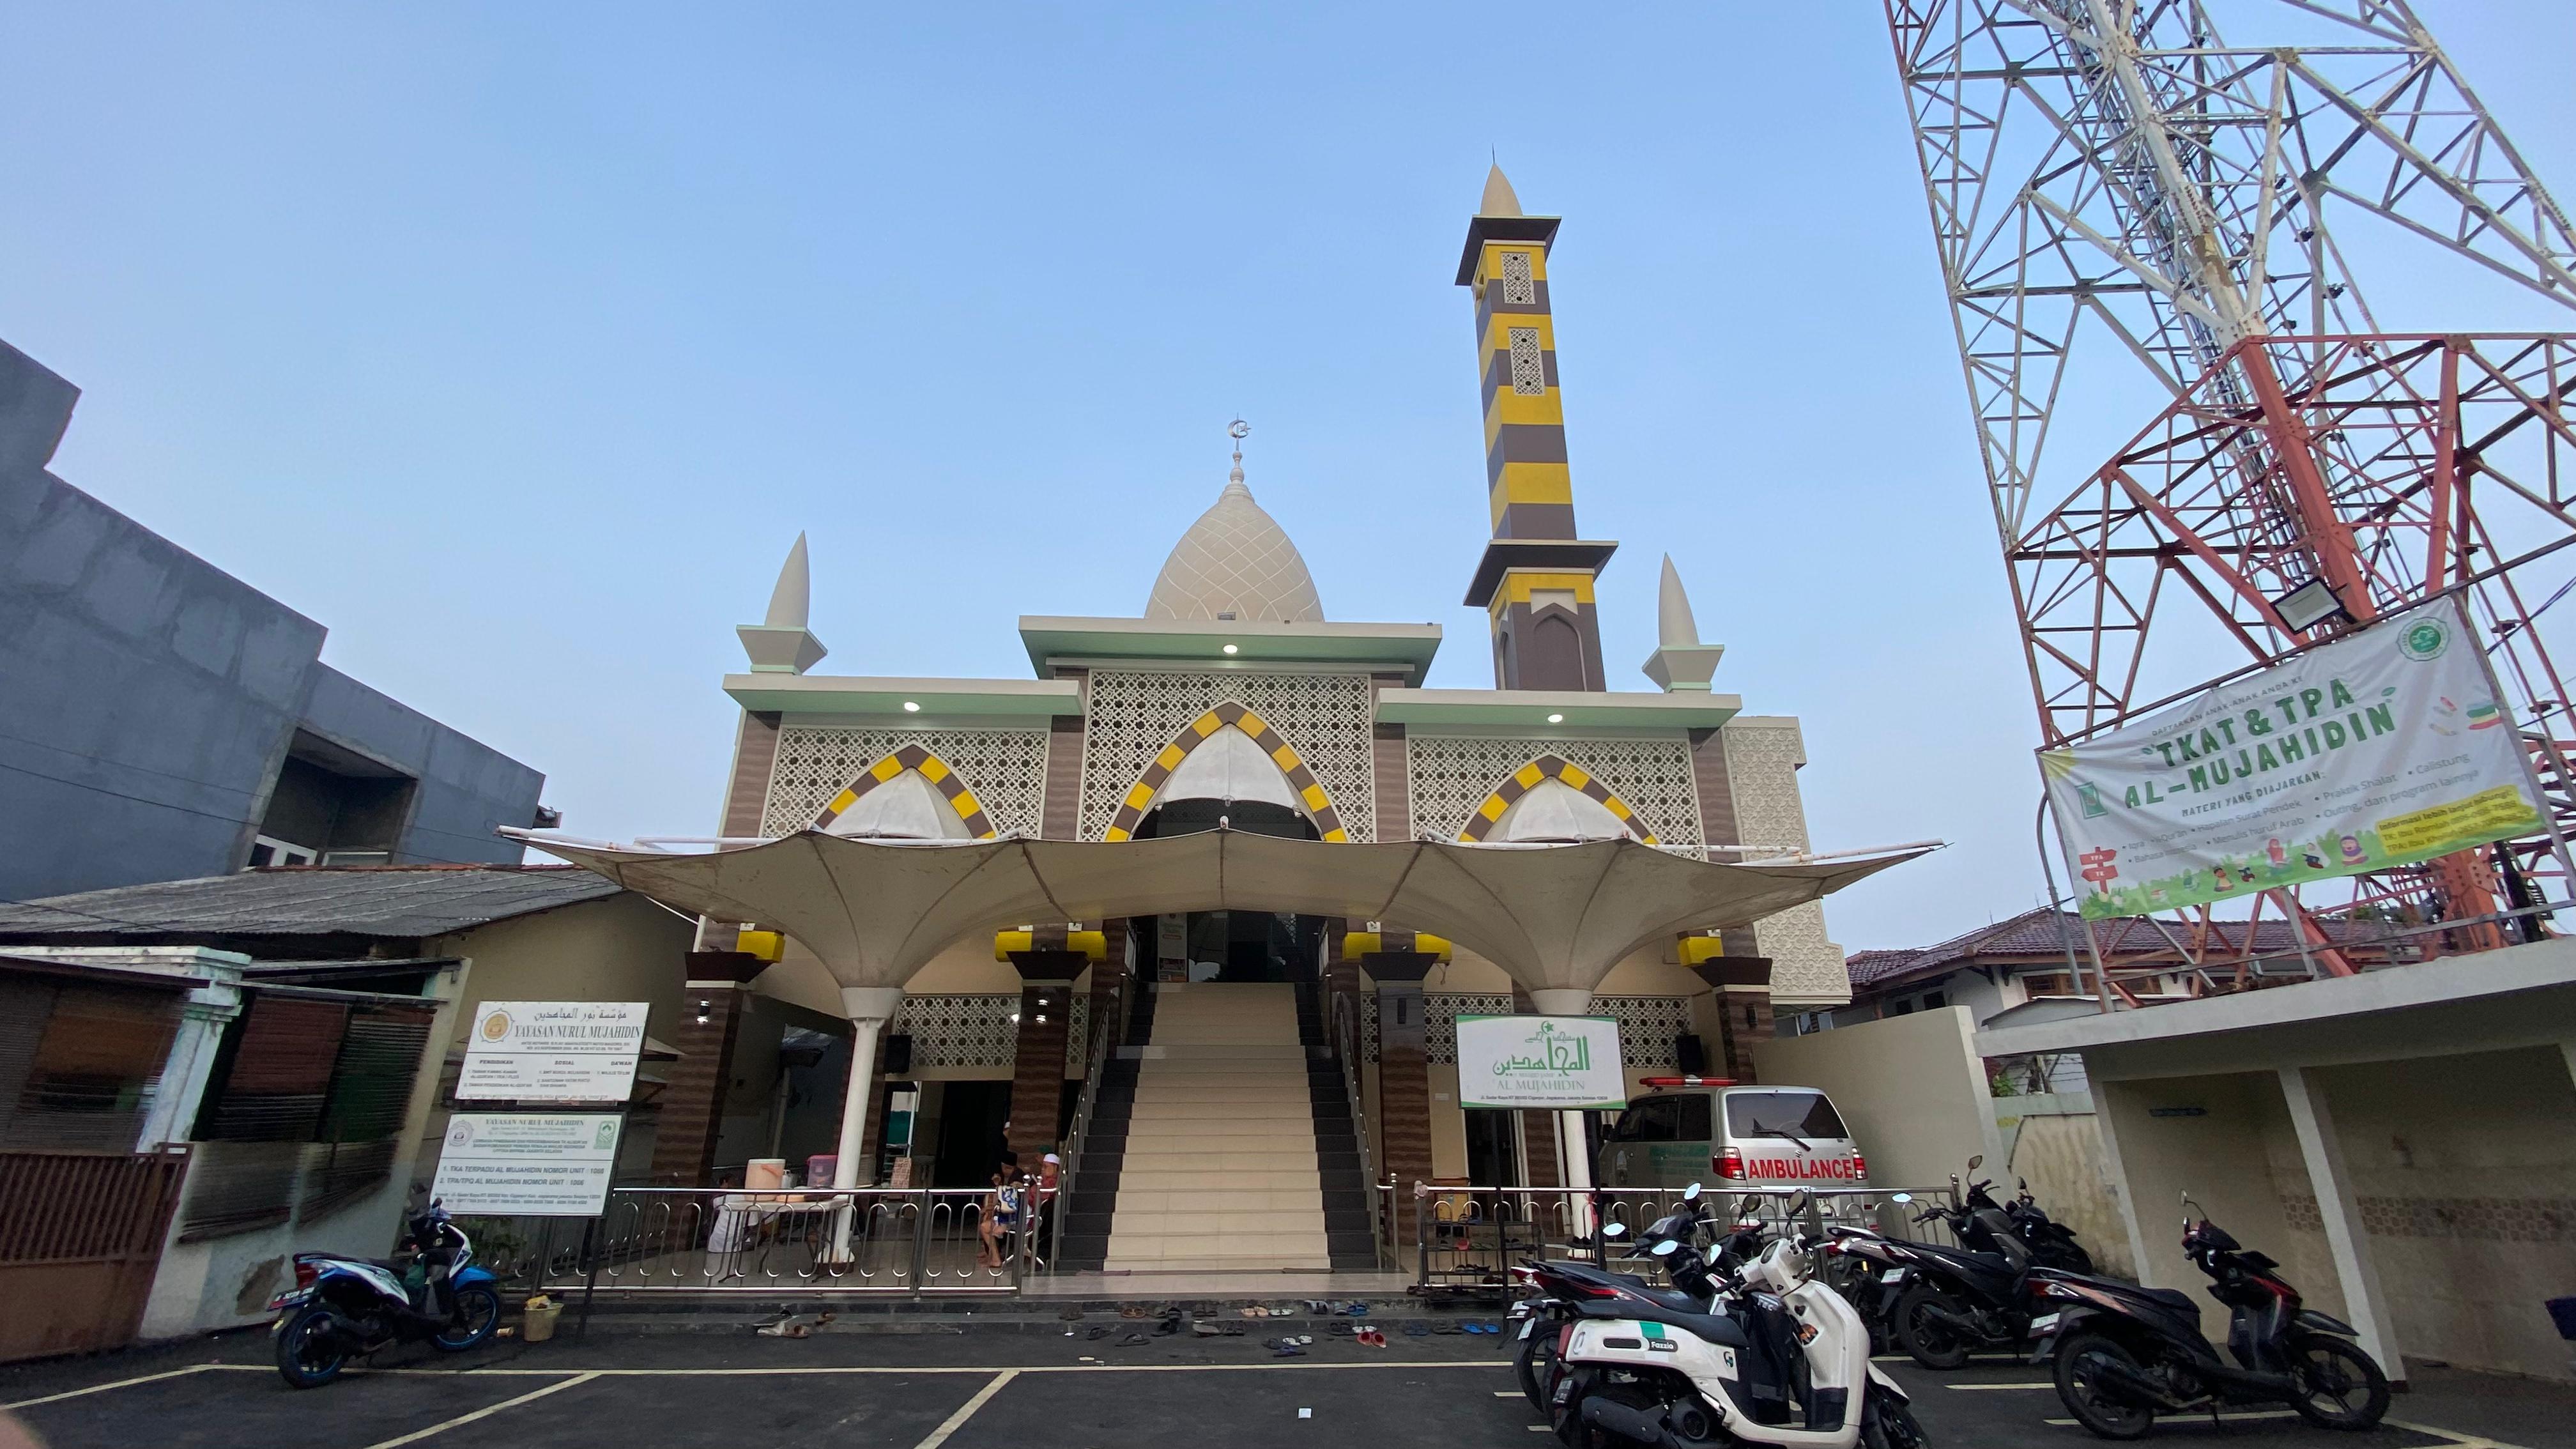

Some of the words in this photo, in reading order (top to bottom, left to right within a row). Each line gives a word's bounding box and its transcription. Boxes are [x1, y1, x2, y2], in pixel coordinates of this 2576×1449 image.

[2152, 714, 2202, 736] DAFTARKAN
[2205, 693, 2258, 716] ANAK-ANAK
[2262, 682, 2288, 696] ANDA
[2156, 717, 2237, 767] TKAT
[2243, 709, 2273, 736] &
[2275, 678, 2355, 725] TPA
[2125, 703, 2396, 809] AL-MUJAHIDIN
[2361, 774, 2398, 790] Shalat
[2416, 753, 2471, 774] Calistung
[2182, 798, 2222, 817] MATERI
[2225, 790, 2253, 806] YANG
[2255, 770, 2326, 798] DIAJARKAN:
[2365, 795, 2388, 808] dan
[2389, 781, 2438, 804] program
[2236, 810, 2262, 823] Surat
[2263, 800, 2302, 815] Pendek
[2279, 816, 2304, 828] Arab
[2379, 815, 2422, 831] Informasi
[514, 1025, 554, 1038] YAYASAN
[556, 1025, 587, 1038] NURUL
[588, 1025, 643, 1039] MUJAHIDIN
[1492, 1035, 1590, 1077] المجاهدين
[1498, 1080, 1513, 1090] AL
[1516, 1080, 1584, 1093] MUJAHIDIN
[1749, 1160, 1854, 1179] AMBULANCE
